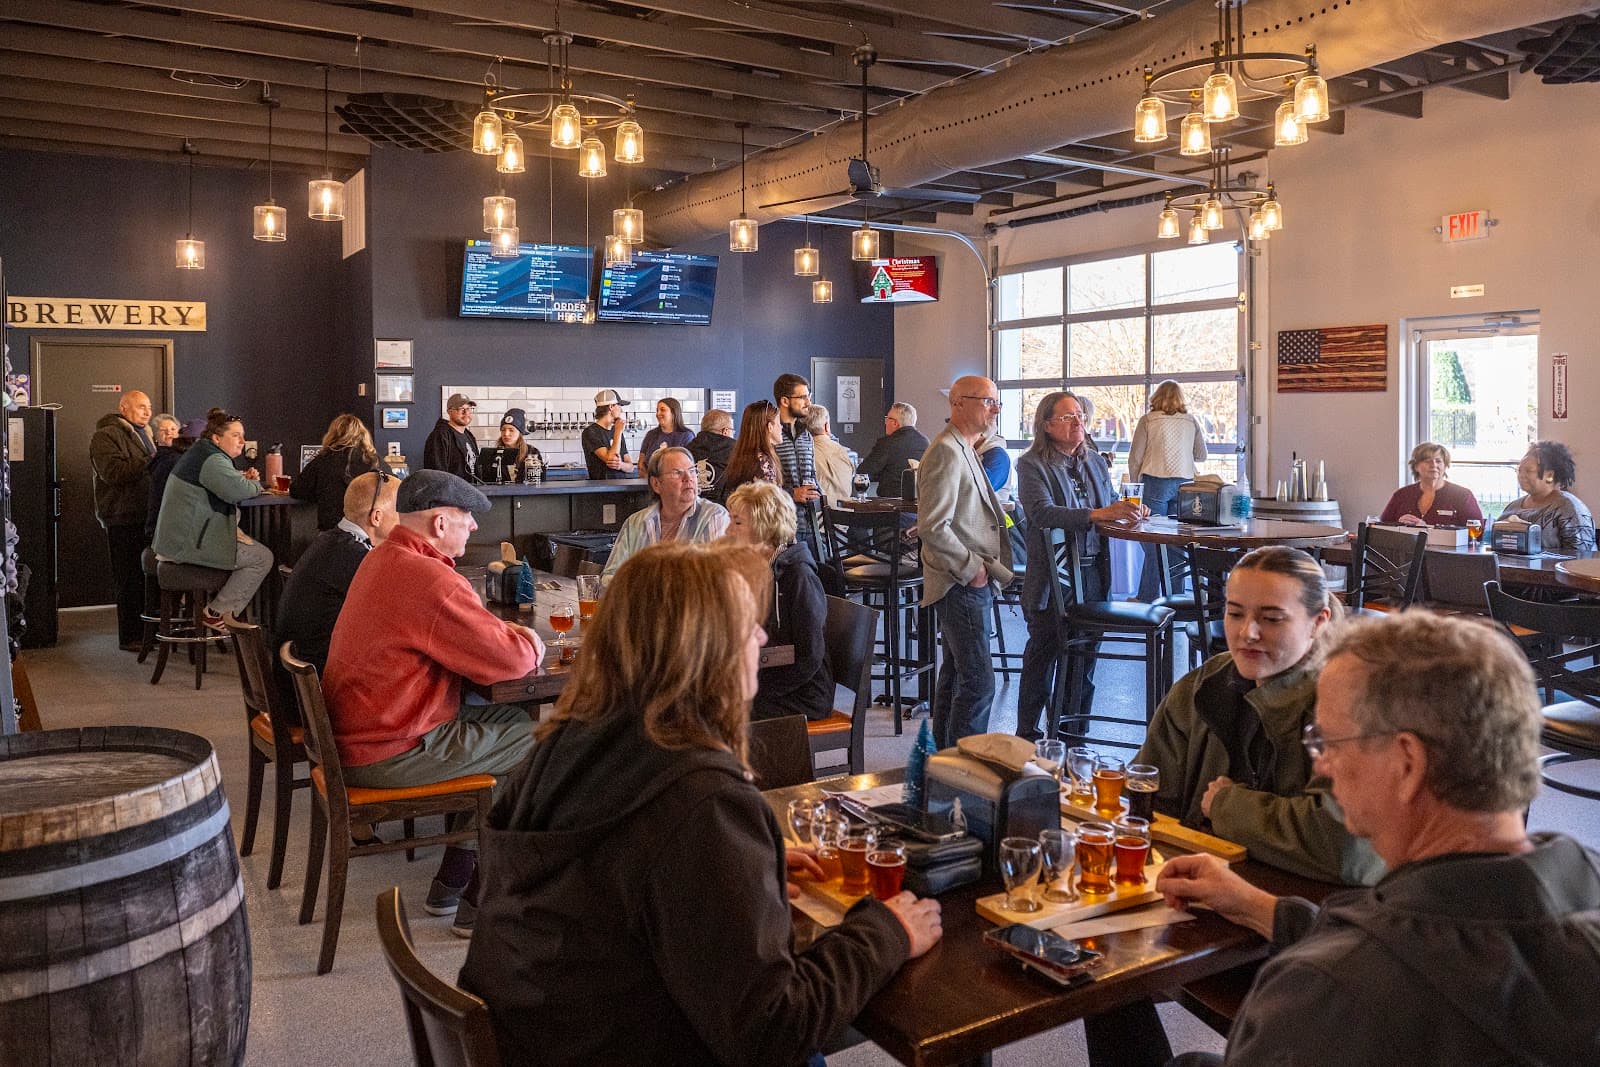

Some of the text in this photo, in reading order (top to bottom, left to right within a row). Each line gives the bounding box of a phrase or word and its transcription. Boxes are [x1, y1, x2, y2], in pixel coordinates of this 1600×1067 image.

[1449, 212, 1480, 239] EXIT
[891, 258, 920, 266] Christmas
[553, 302, 587, 312] ORDER
[8, 302, 195, 326] BREWERY
[557, 312, 584, 322] HERE
[1553, 358, 1567, 366] FIRE
